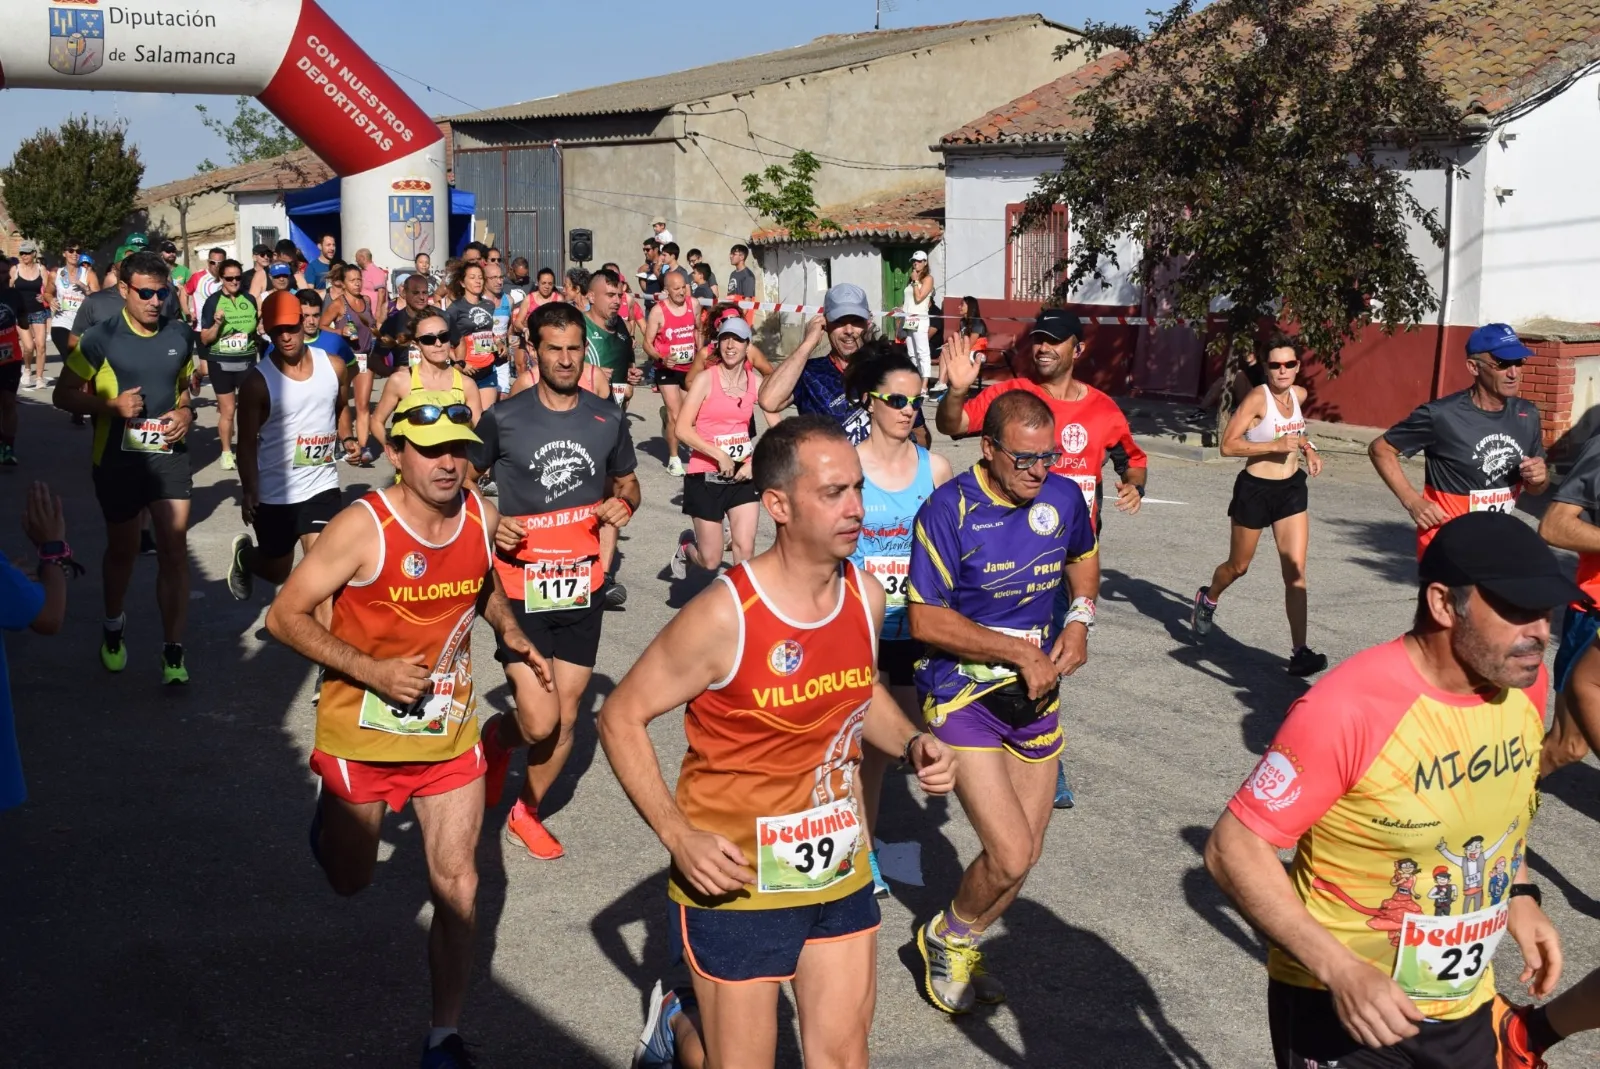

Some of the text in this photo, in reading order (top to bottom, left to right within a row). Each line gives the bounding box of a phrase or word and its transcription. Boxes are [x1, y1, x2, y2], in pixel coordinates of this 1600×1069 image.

[109, 7, 216, 29] Diputación
[108, 45, 236, 65] de Salamanca
[306, 35, 413, 142] CON NUESTROS
[296, 56, 393, 151] DEPORTISTAS
[680, 351, 689, 359] 28
[141, 432, 160, 444] 12
[305, 445, 329, 459] 127
[729, 444, 744, 457] 29
[527, 514, 554, 529] COCA
[556, 512, 570, 527] DE
[983, 560, 1015, 573] Jamón
[539, 579, 577, 599] 117
[752, 666, 873, 708] VILLORUELA
[1415, 734, 1533, 794] MIGUEL
[760, 808, 857, 846] bedunia
[795, 837, 834, 873] 39
[1404, 910, 1508, 947] bedunia
[1437, 943, 1484, 981] 23
